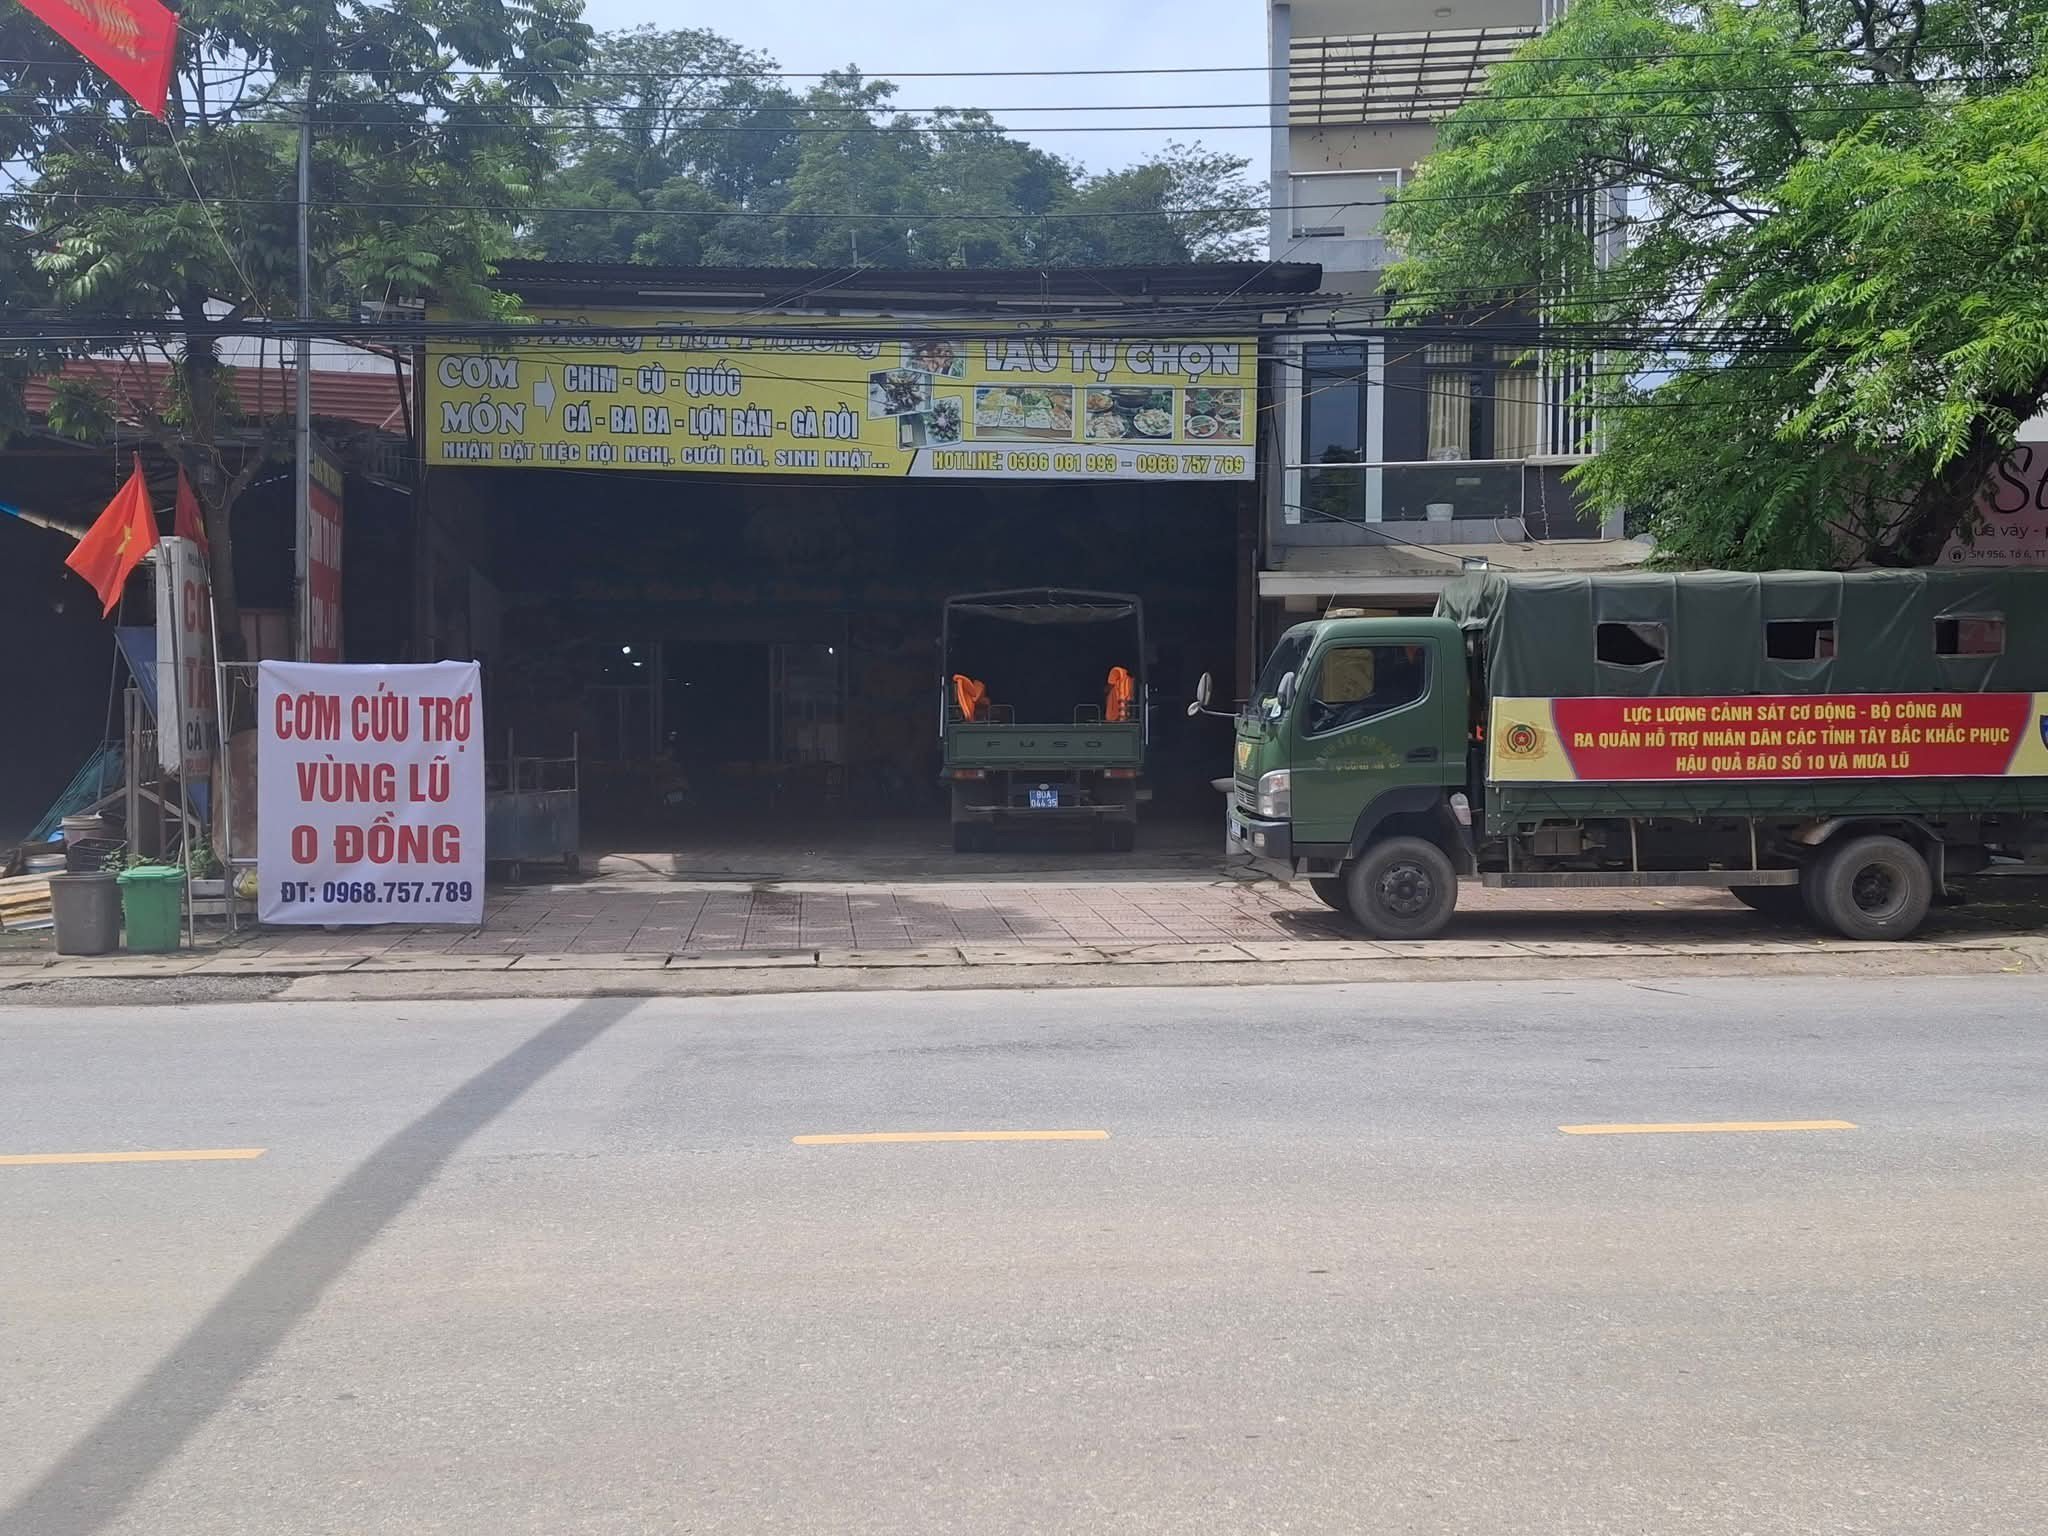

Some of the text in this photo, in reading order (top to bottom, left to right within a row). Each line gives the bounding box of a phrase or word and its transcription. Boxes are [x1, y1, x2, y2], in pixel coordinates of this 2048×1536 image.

[438, 355, 519, 388] CƠM
[1126, 340, 1240, 383] CHỌN
[563, 364, 618, 393] CHIM
[637, 361, 665, 394] CÒ
[685, 359, 741, 398] QUỐC
[441, 393, 526, 435] MÓN
[563, 400, 592, 432] CÁ
[610, 405, 638, 433] BA
[643, 406, 671, 434] BA
[688, 404, 726, 440] LỢN
[731, 403, 772, 437] BẢN
[791, 406, 819, 438] GÀ
[823, 402, 859, 439] ĐỒI
[442, 439, 493, 462] NHẬN
[499, 440, 535, 463] ĐẶT
[540, 440, 580, 464] TIỆC
[586, 441, 618, 465] HỘI
[681, 444, 725, 465] CƯỚI
[775, 449, 819, 467] SINH
[932, 451, 1003, 470] HOTLINE:
[1007, 452, 1049, 471] 0386
[1054, 453, 1081, 472] 081
[1086, 454, 1117, 473] 993
[1136, 454, 1178, 473] 0968
[1182, 455, 1211, 473] 757
[275, 691, 340, 740] CƠM
[351, 682, 409, 742] CỨU
[419, 692, 473, 752] TRỢ
[1623, 706, 1651, 726] LỰC
[1657, 705, 1706, 726] LƯỢNG
[1711, 702, 1752, 722] CẢNH
[1757, 702, 1785, 720] SÁT
[1790, 703, 1811, 719] CƠ
[1814, 701, 1856, 722] ĐỘNG
[1871, 701, 1891, 722] BỘ
[1896, 701, 1936, 719] CÔNG
[1941, 703, 1962, 719] AN
[986, 740, 1102, 748] FUSO
[1574, 722, 2010, 749] RA QUÂN HỖ TRỢ NHÂN DÂN CÁC TỈNH TÂY BẮC KHẮC PHỤC
[296, 754, 450, 802] VÙNG LŨ
[1675, 750, 1910, 774] HẬU QUẢ BÃO SỐ 10 VÀ MƯA LŨ
[333, 811, 460, 864] ĐỒNG
[281, 881, 472, 903] ĐT: 0968.757.789
